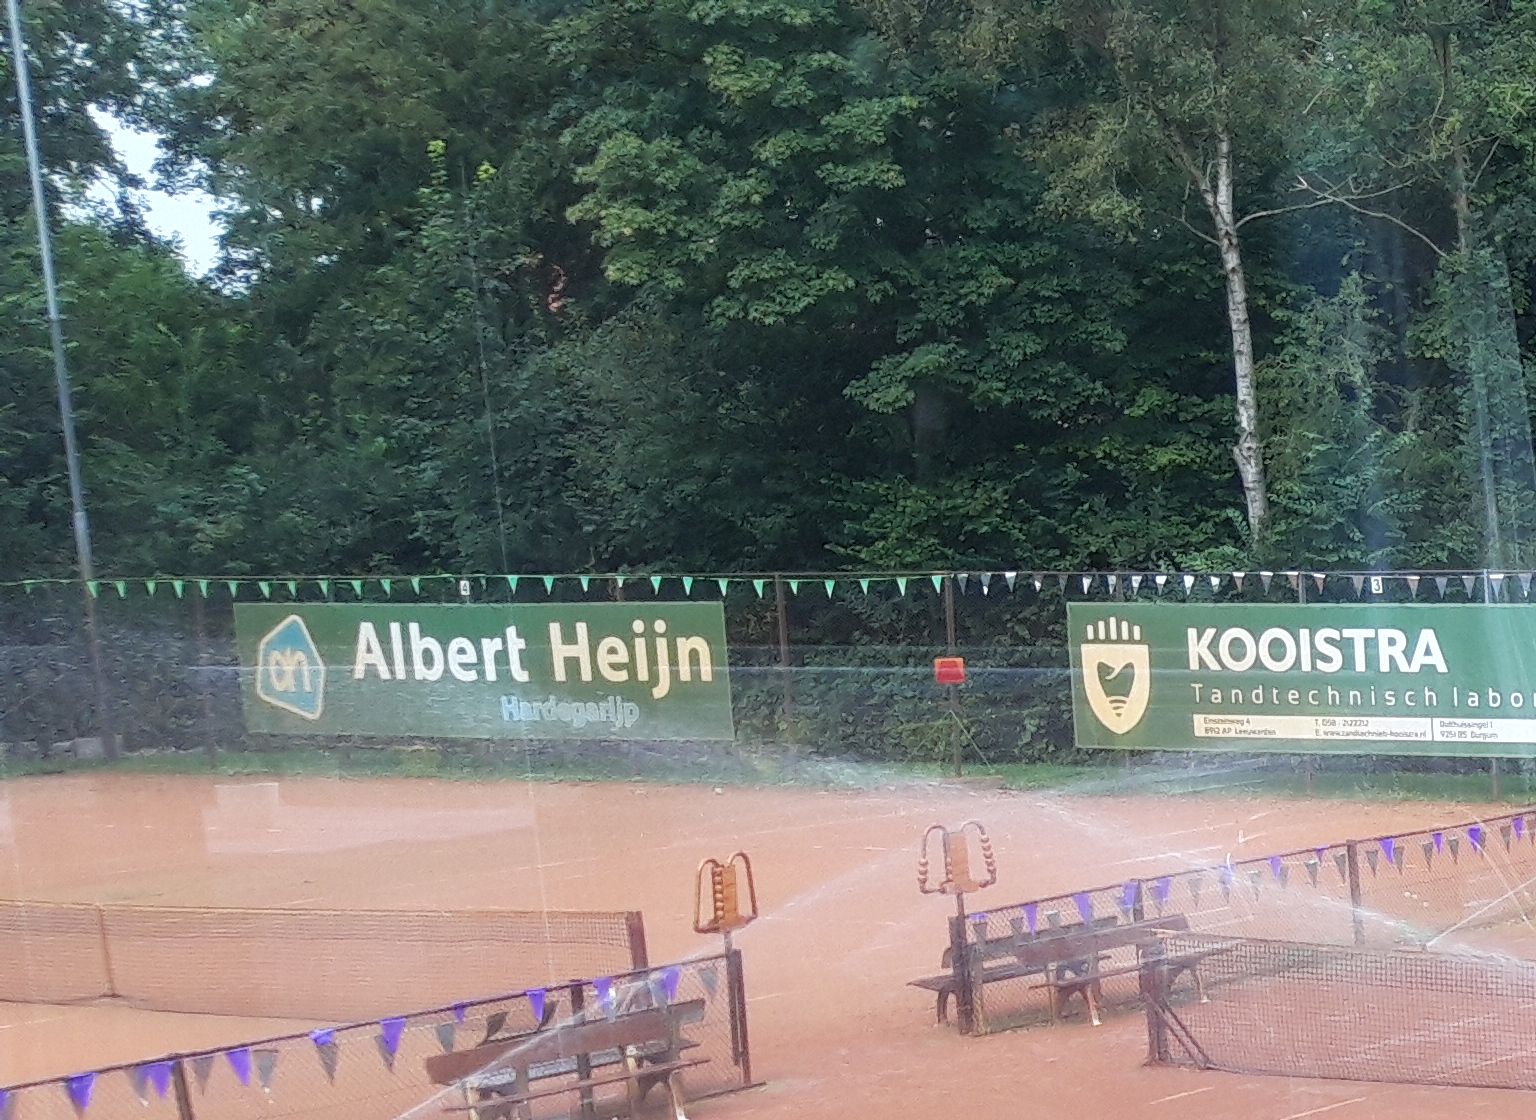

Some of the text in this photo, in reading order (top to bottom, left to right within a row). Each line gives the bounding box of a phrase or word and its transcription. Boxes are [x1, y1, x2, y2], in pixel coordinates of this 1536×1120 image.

[353, 618, 713, 700] Albert Heijn
[1186, 627, 1448, 674] KOOISTRA
[1190, 683, 1436, 707] Tandtechnisch
